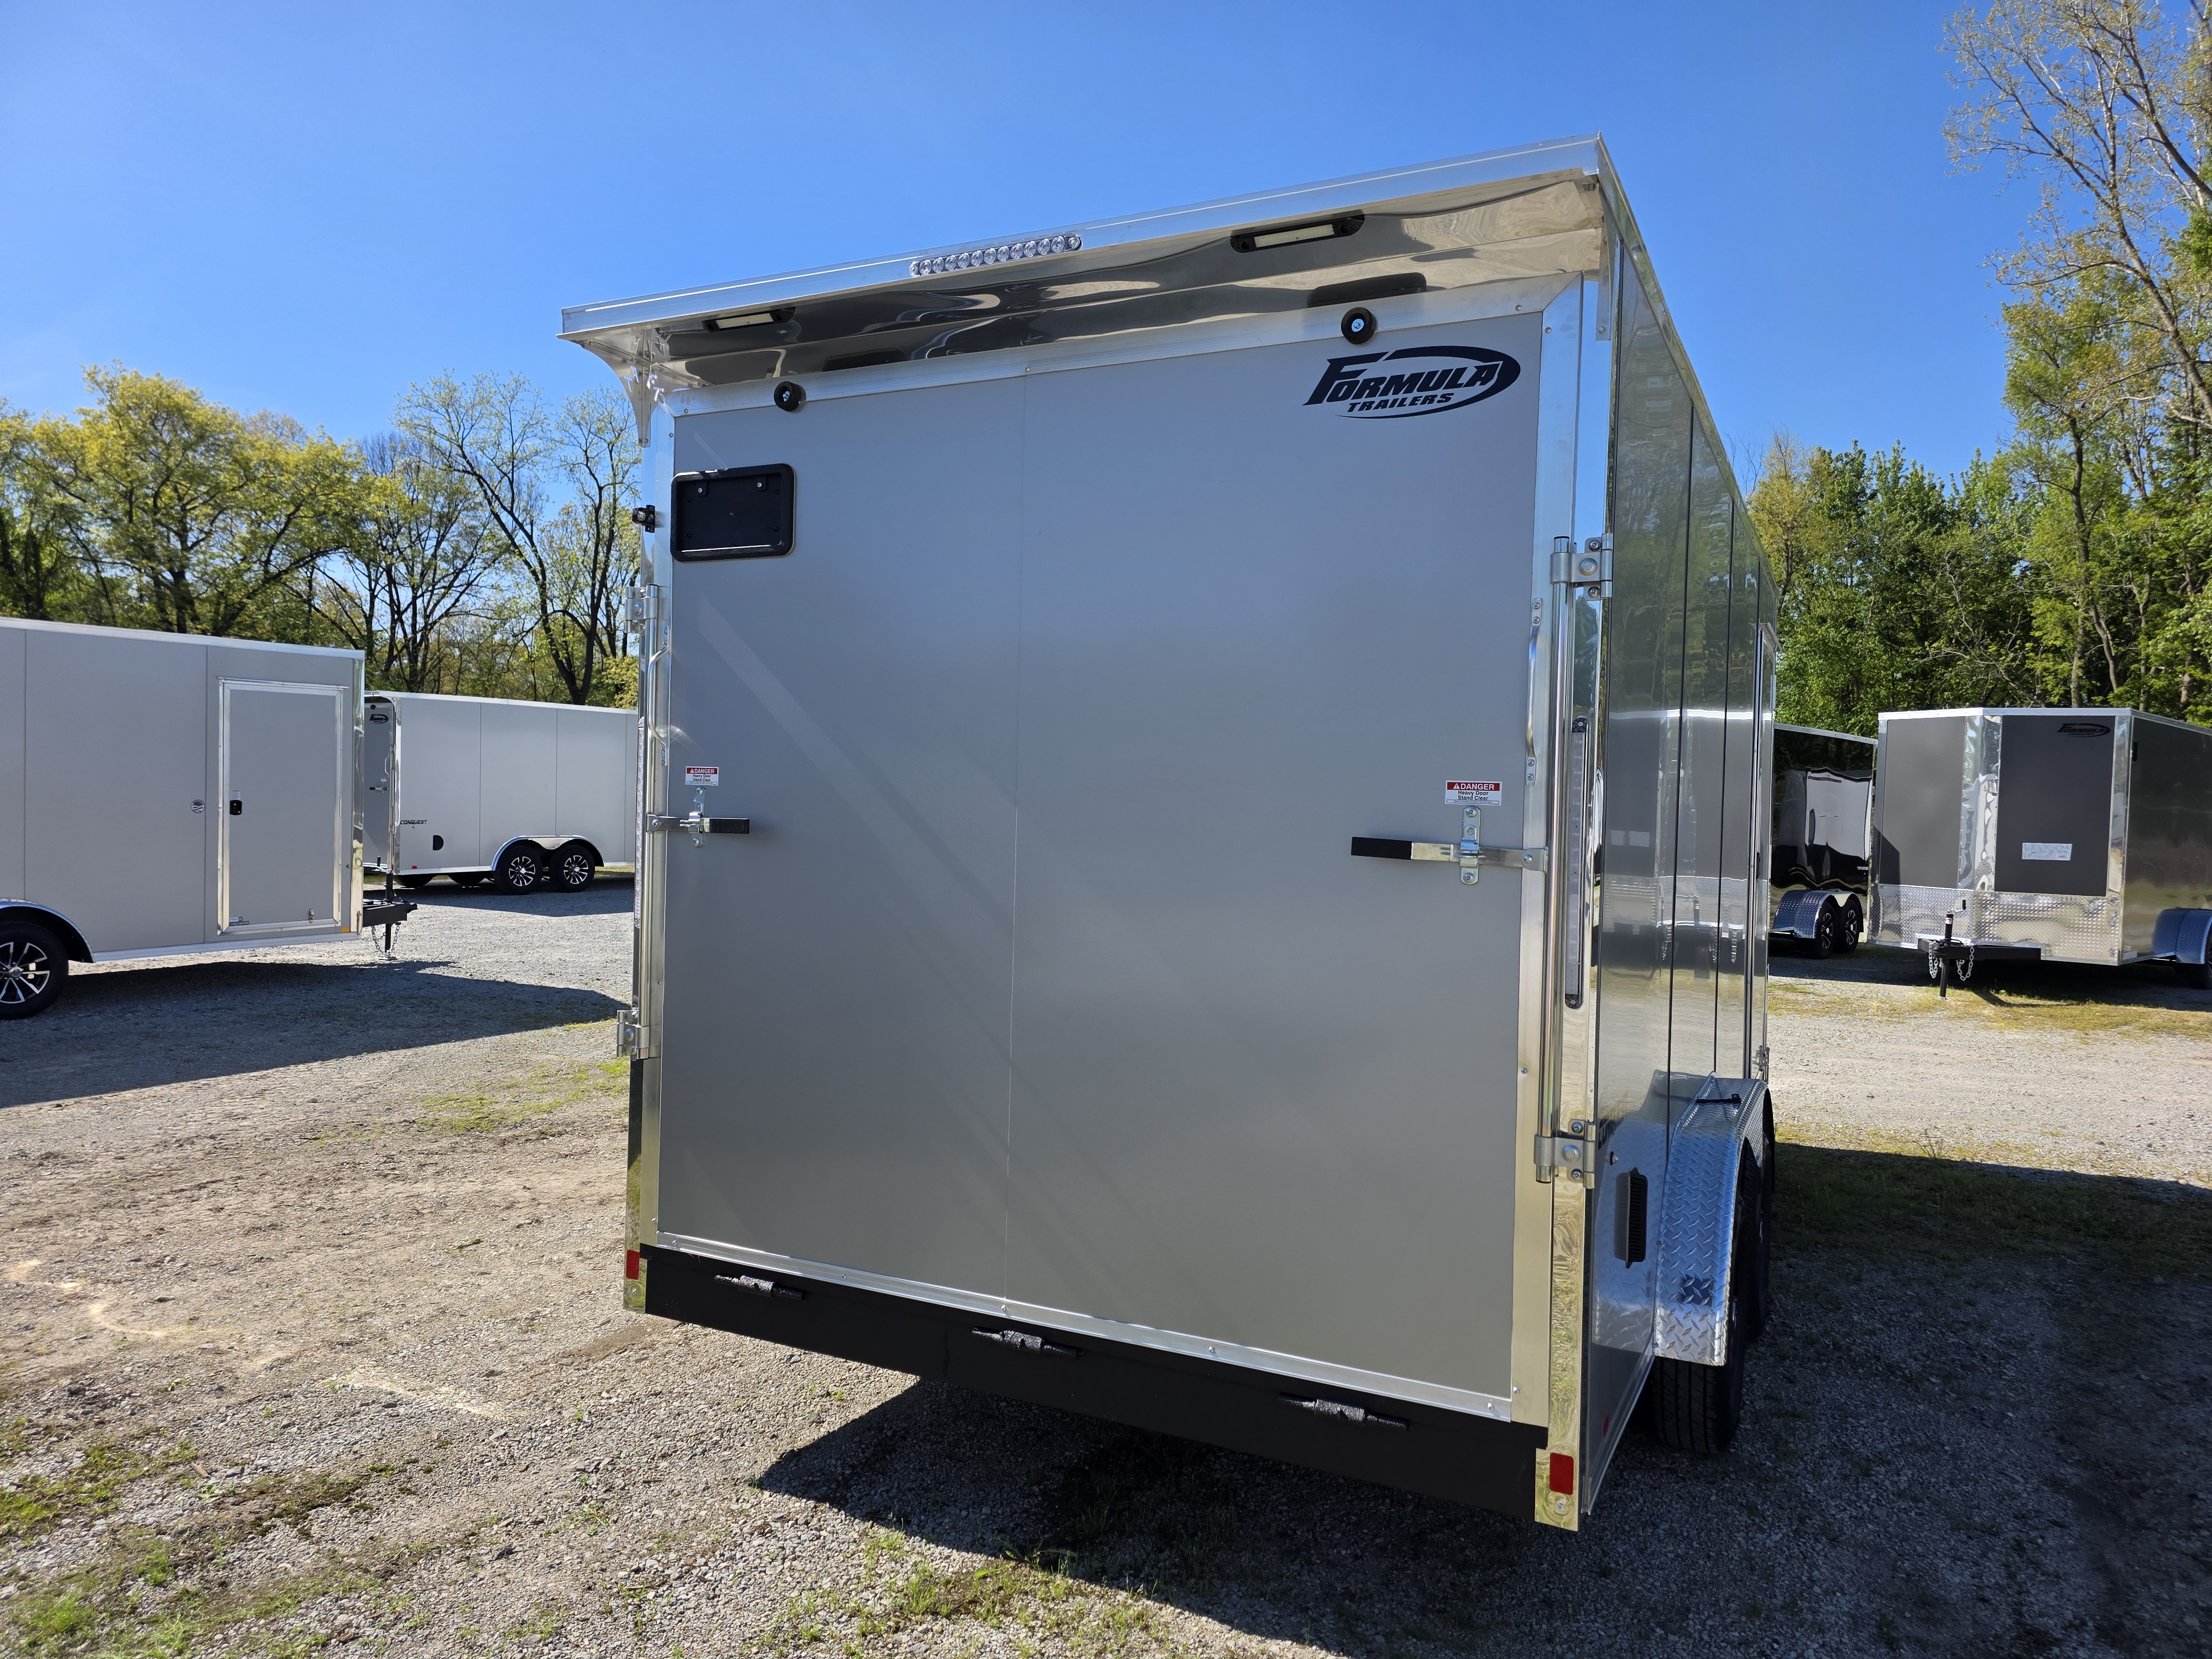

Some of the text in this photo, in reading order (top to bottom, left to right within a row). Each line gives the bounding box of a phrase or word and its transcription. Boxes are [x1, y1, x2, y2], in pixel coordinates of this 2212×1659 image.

[1302, 352, 1500, 406] FORMULA
[1347, 393, 1454, 413] TRAILERS
[2057, 723, 2105, 733] FORMULA
